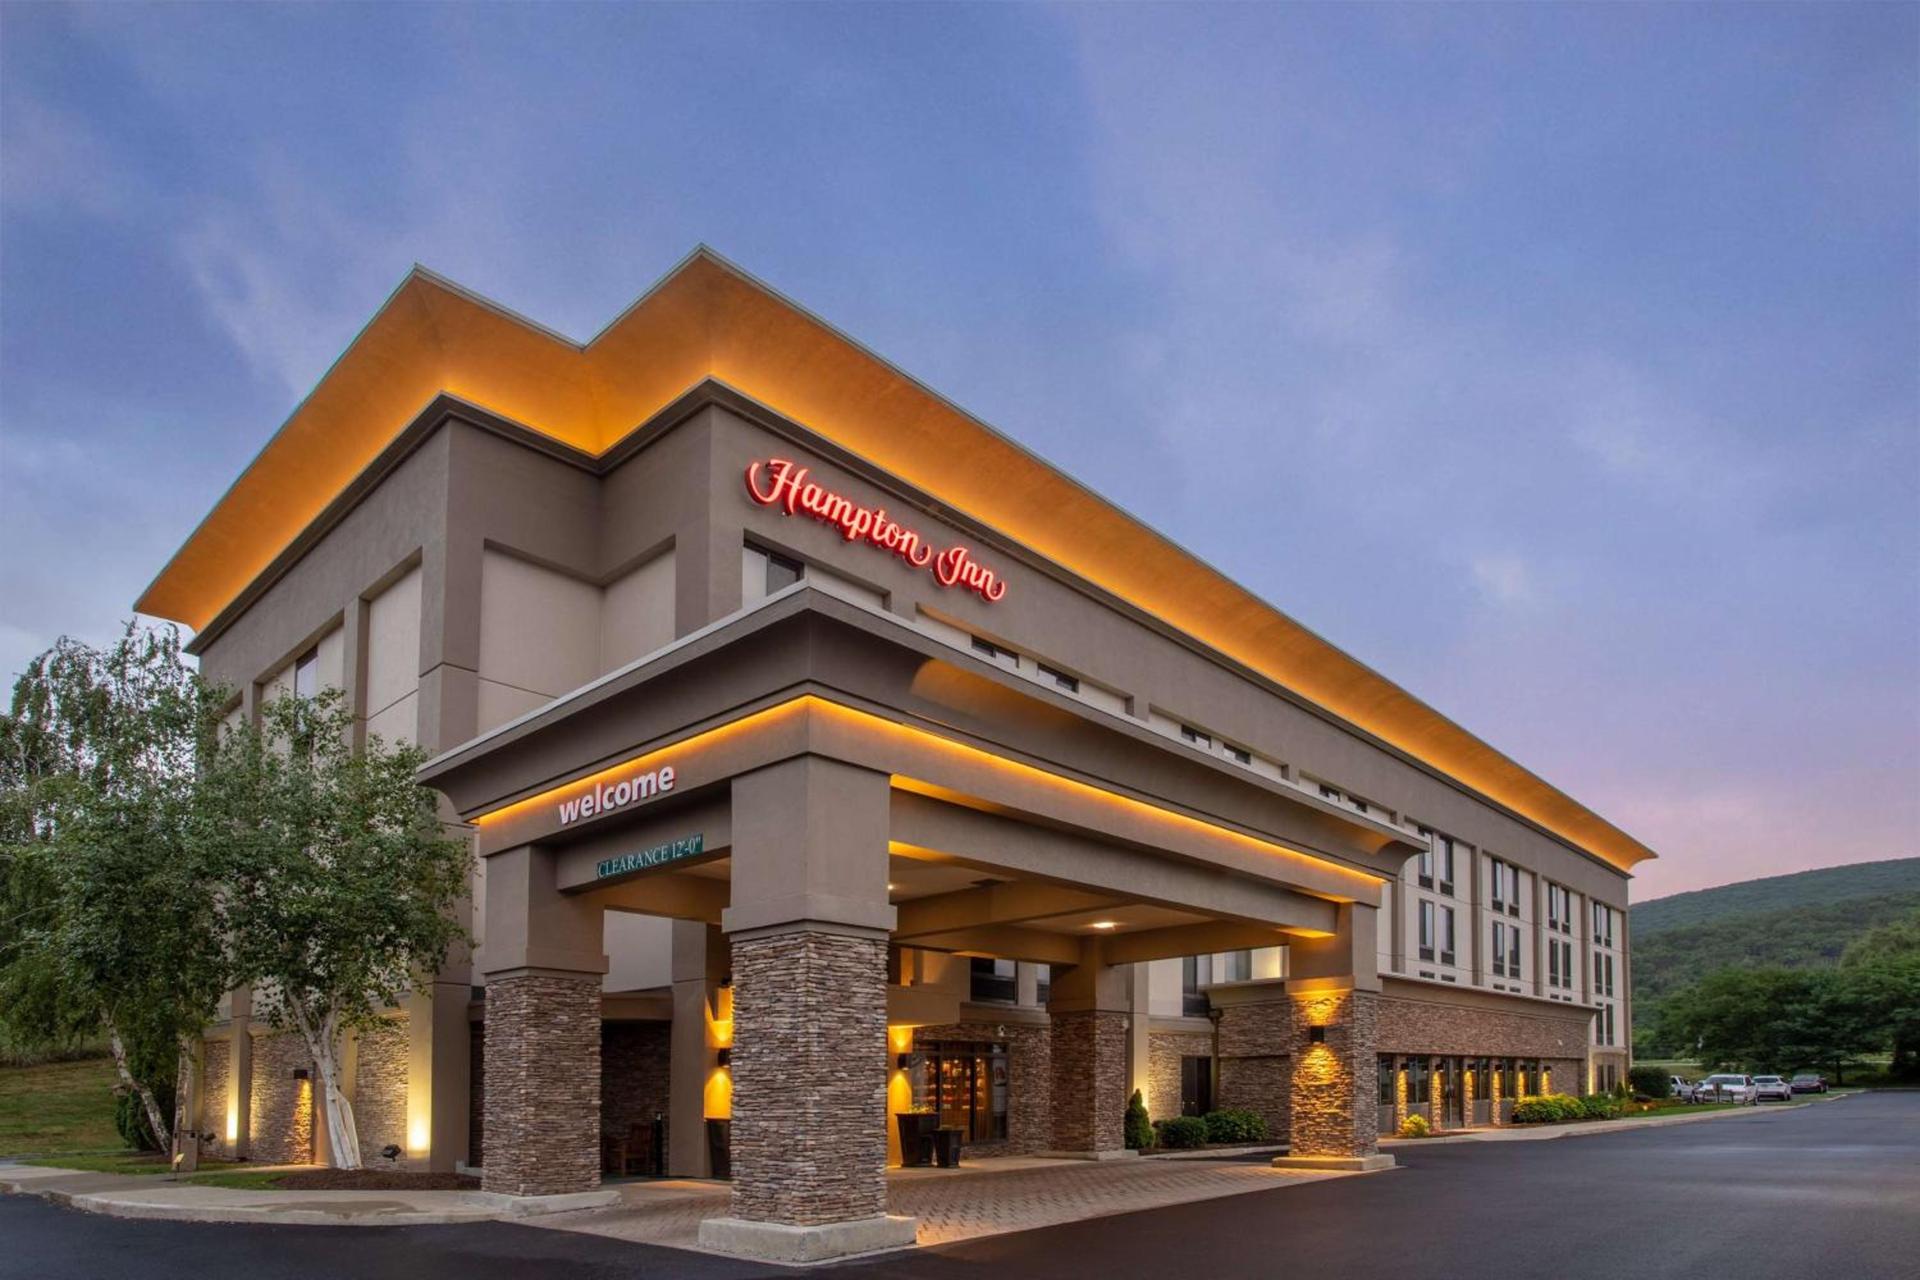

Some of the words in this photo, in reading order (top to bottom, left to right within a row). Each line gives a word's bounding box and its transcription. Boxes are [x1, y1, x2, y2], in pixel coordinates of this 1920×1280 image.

[745, 459, 932, 567] Hampton
[932, 546, 1005, 601] Inn
[559, 766, 675, 825] welcome
[598, 846, 669, 878] CLEARANCE
